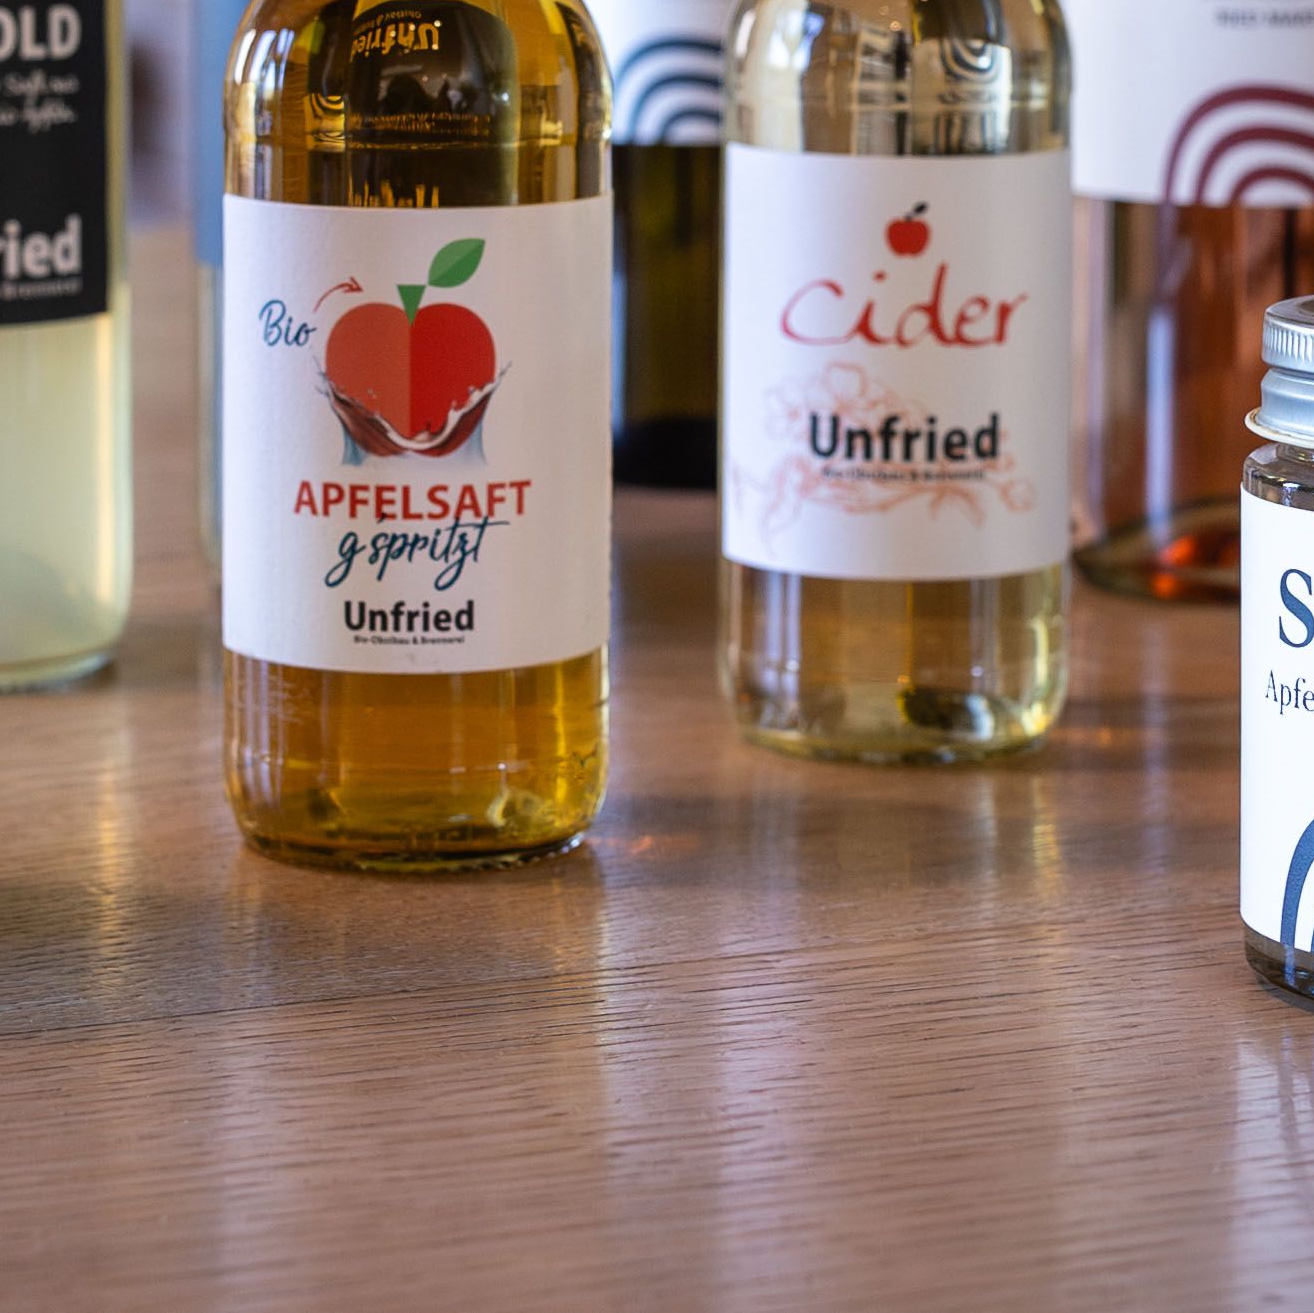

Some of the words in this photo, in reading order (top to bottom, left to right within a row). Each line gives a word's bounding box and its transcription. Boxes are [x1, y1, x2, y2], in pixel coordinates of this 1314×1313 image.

[258, 298, 318, 348] Bio
[779, 261, 1029, 348] Cider
[809, 410, 1002, 462] Unfried
[293, 479, 533, 521] APFELSAFT
[344, 600, 474, 632] Unfried
